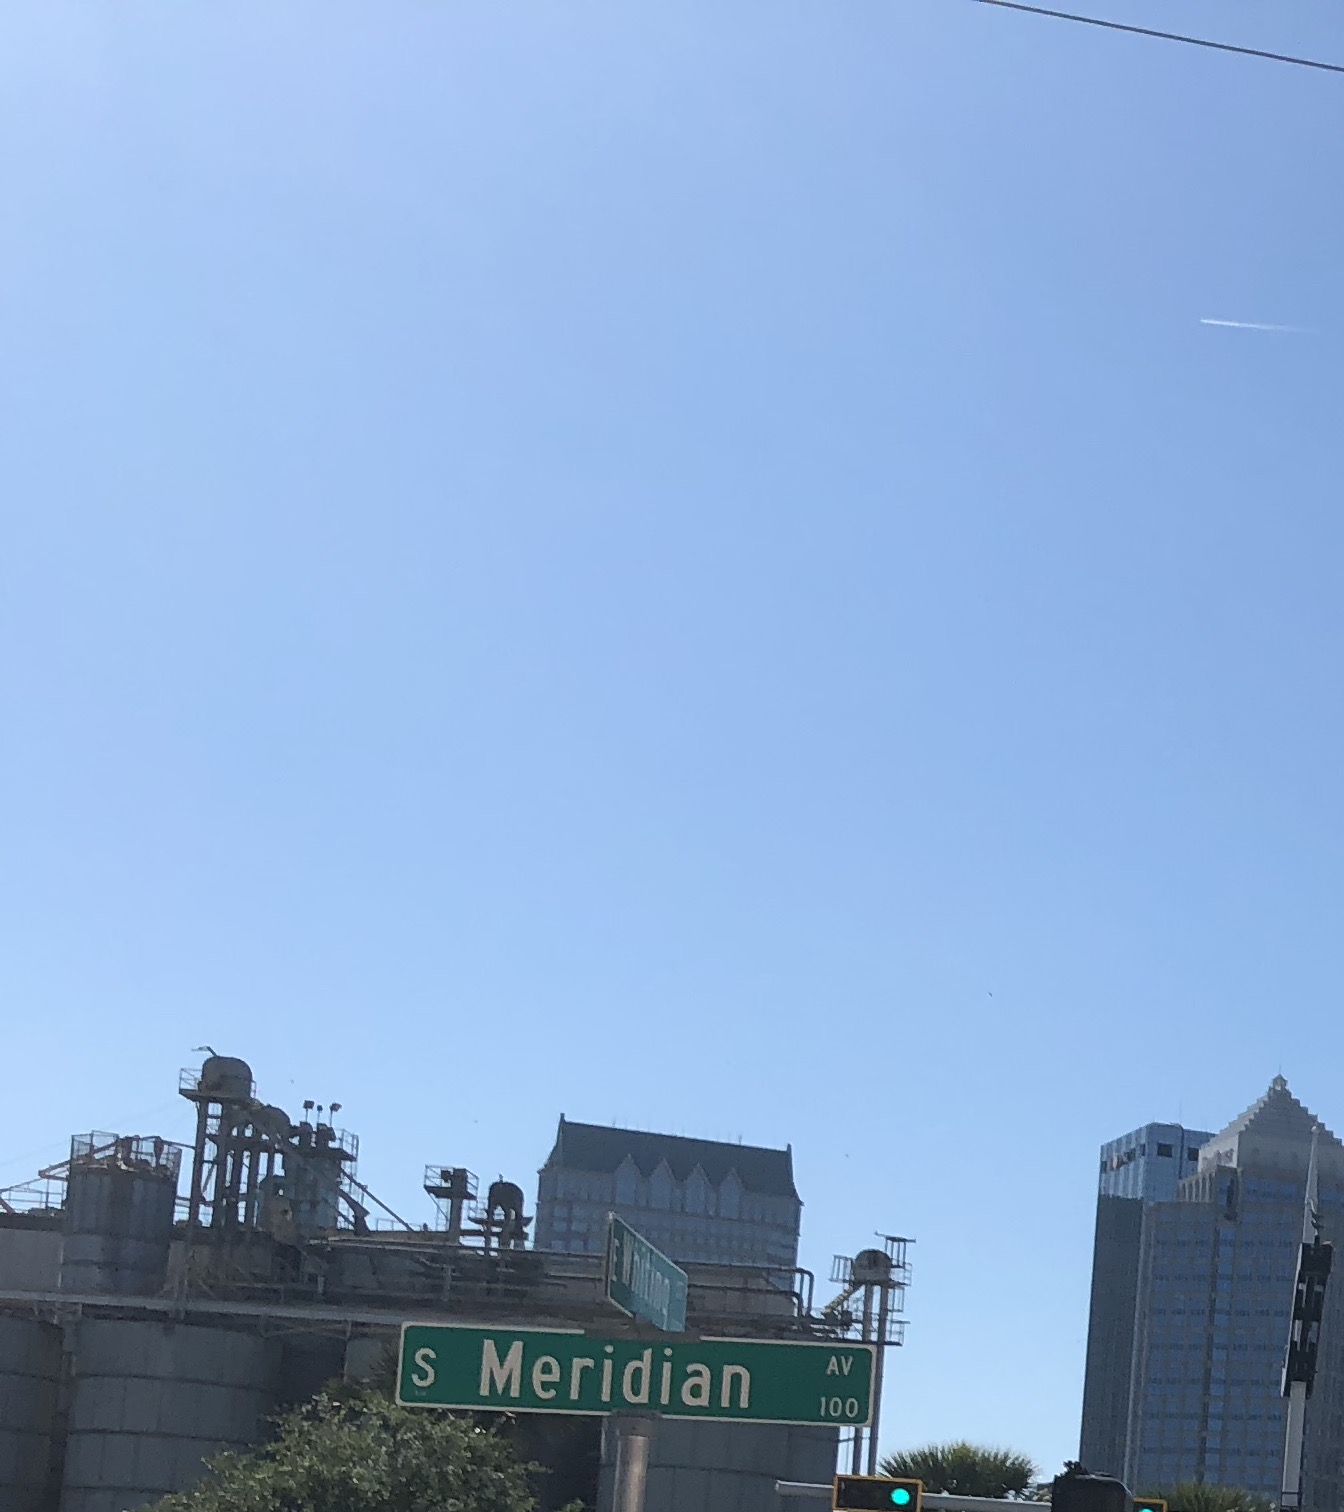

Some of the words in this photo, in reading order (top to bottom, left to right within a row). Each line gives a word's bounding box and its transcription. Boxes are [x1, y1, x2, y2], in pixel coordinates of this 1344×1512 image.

[411, 1347, 437, 1387] S
[479, 1338, 752, 1408] Meridian
[826, 1355, 854, 1377] AV
[819, 1396, 859, 1418] 100
